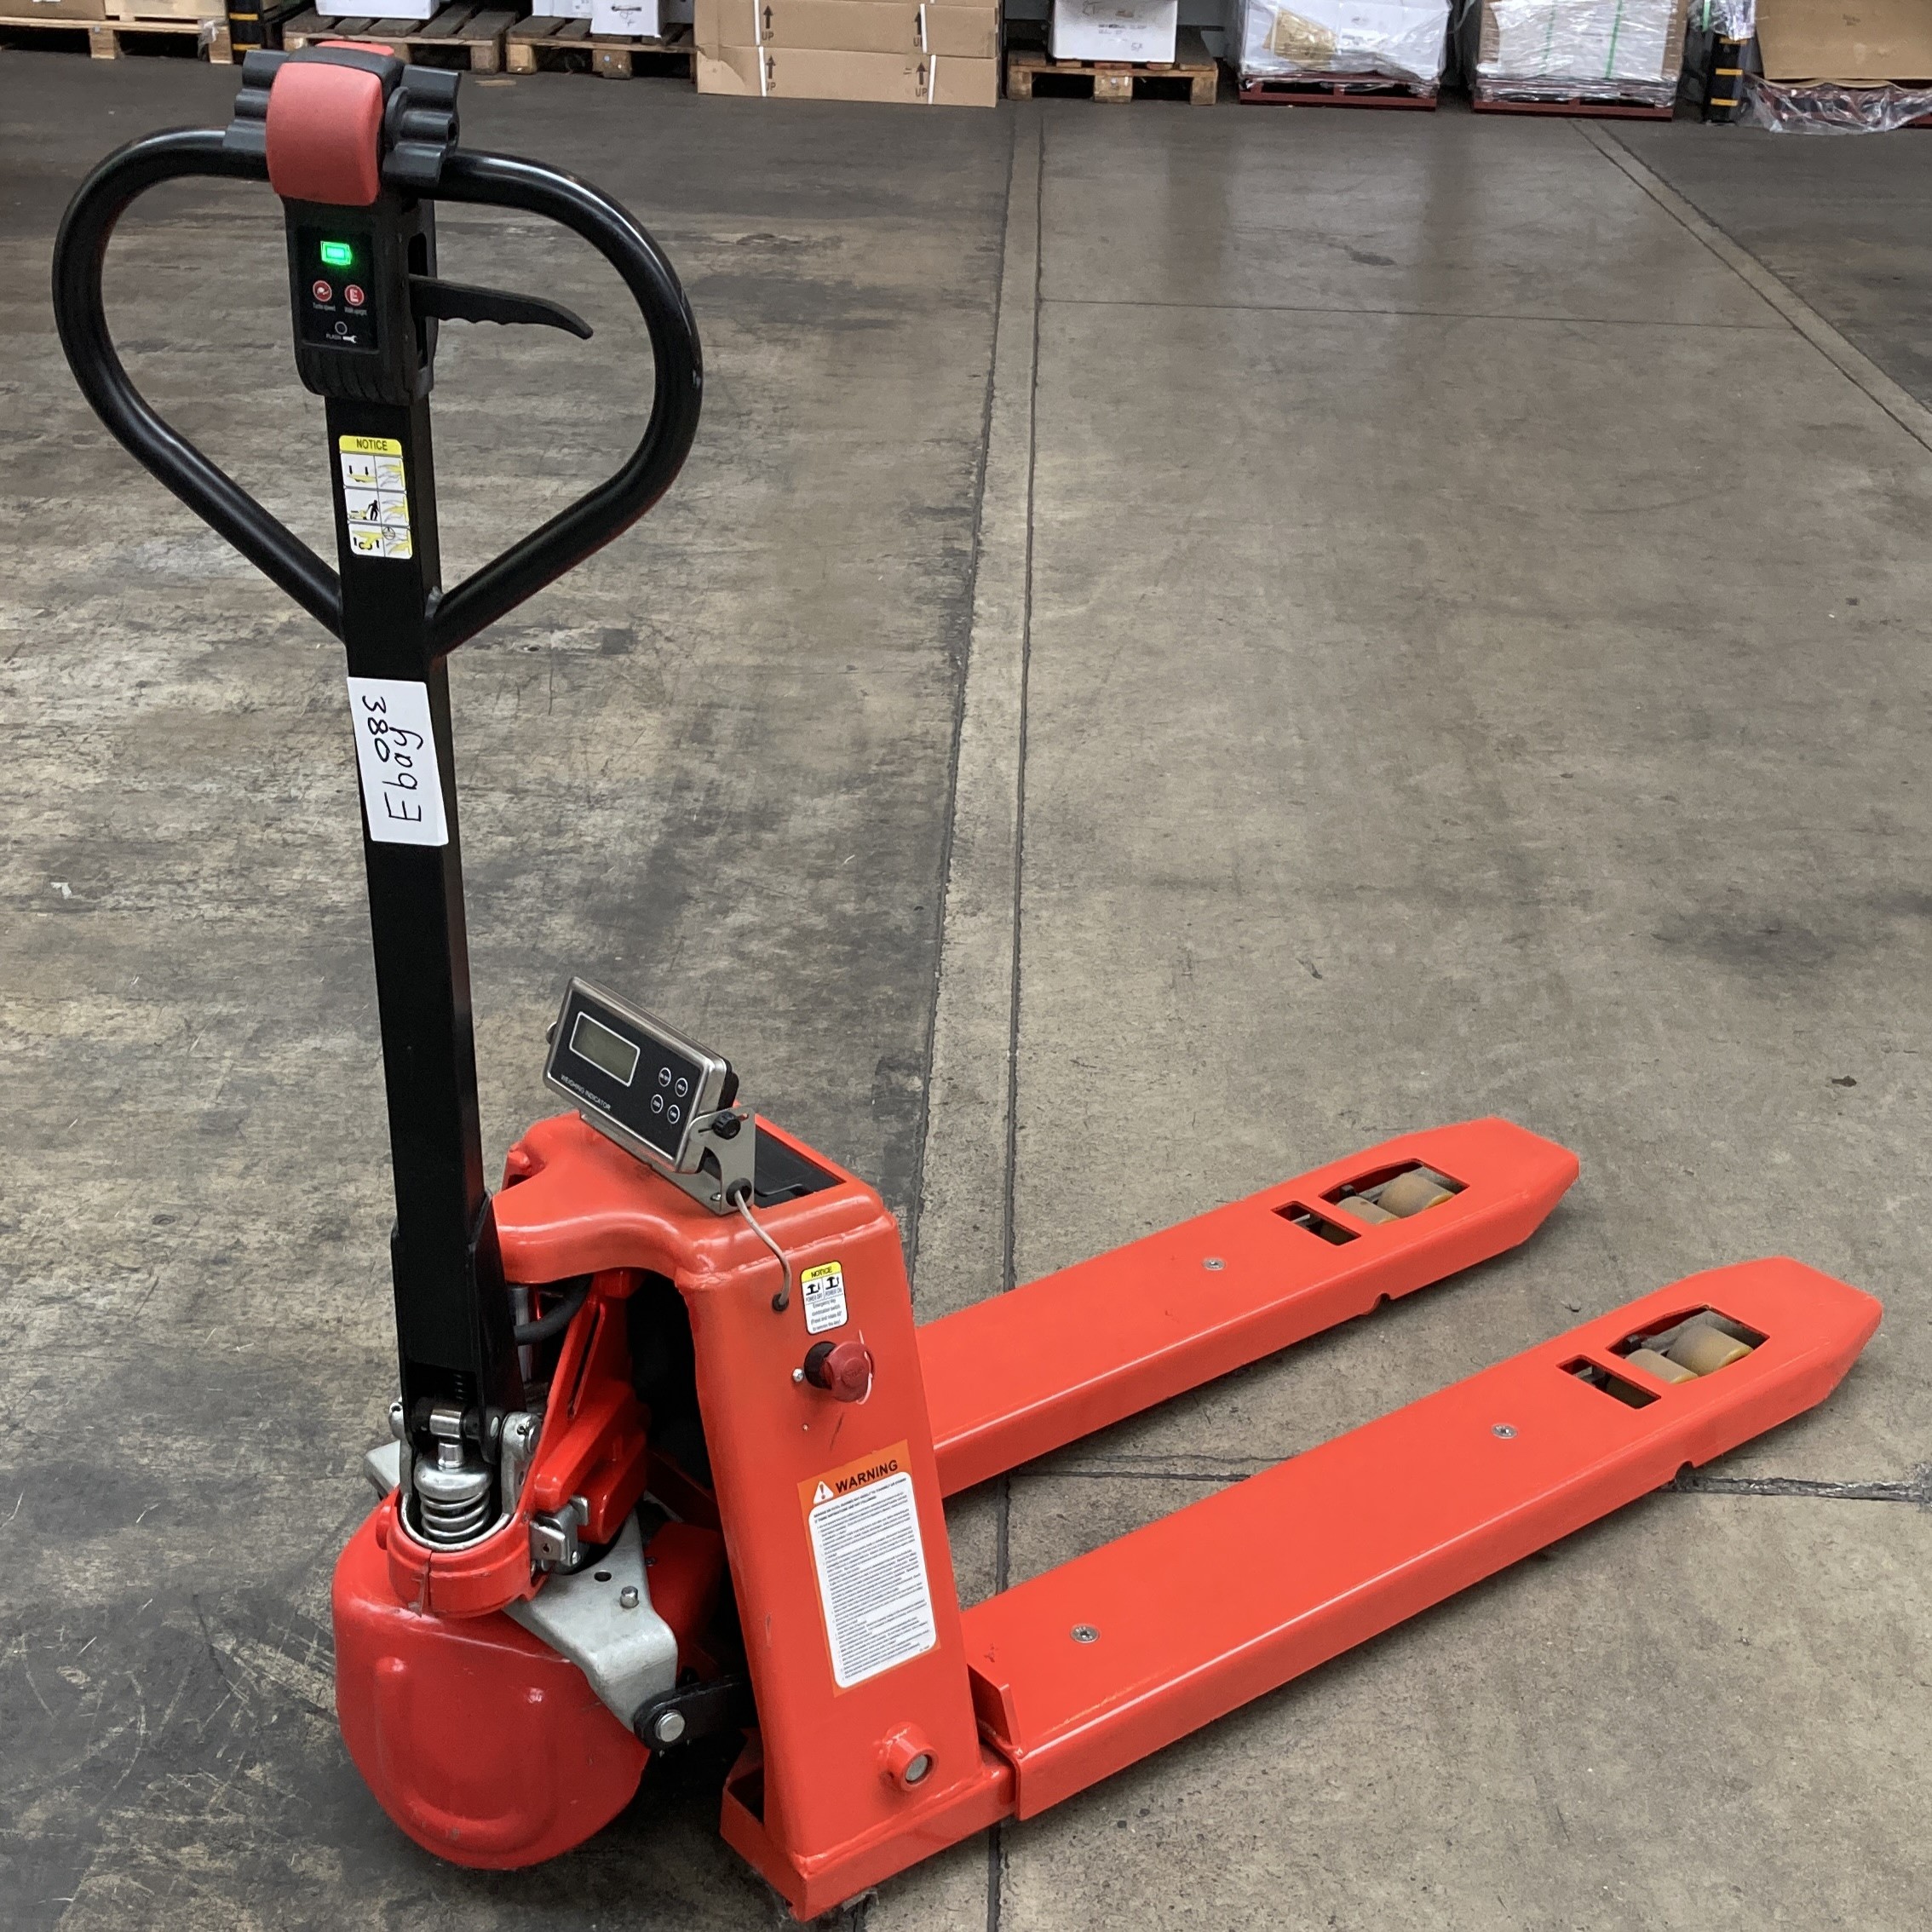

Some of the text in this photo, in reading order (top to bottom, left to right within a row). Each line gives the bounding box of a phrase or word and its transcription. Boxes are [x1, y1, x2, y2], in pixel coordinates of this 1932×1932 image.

[762, 31, 774, 41] UP
[913, 37, 923, 47] U
[915, 88, 928, 98] UP
[356, 438, 388, 451] NOTICE
[362, 695, 390, 762] 380
[382, 727, 424, 822] Ebay
[561, 1073, 612, 1111] WEIGHING INDICATOR
[810, 1266, 833, 1279] NOTICE
[835, 1459, 899, 1494] WARNING
